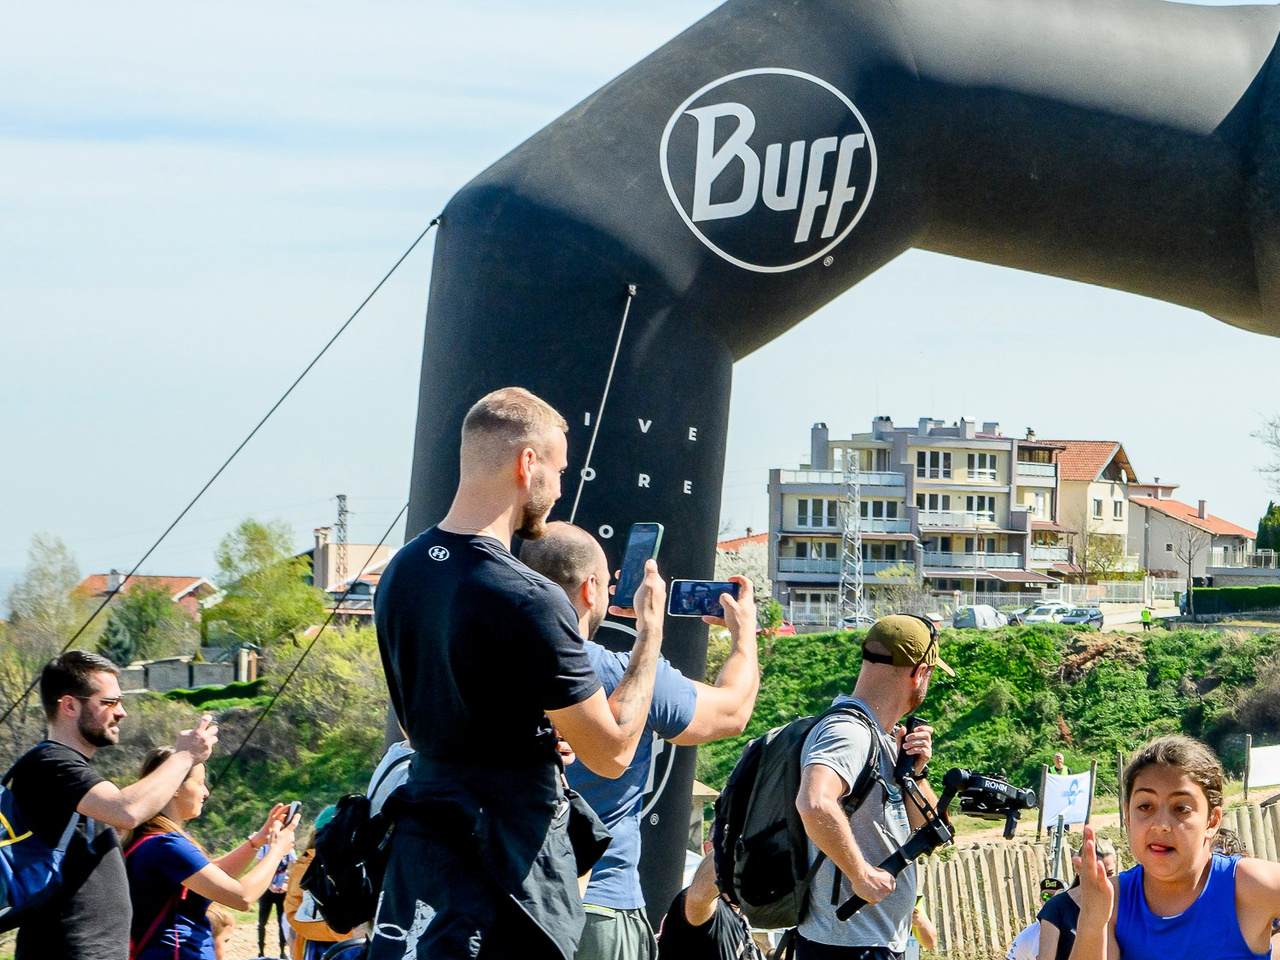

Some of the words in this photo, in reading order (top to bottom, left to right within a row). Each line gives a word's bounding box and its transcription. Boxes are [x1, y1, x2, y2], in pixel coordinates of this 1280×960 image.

[583, 412, 698, 442] IVE
[580, 466, 692, 495] ORE
[984, 780, 1008, 792] RONIN
